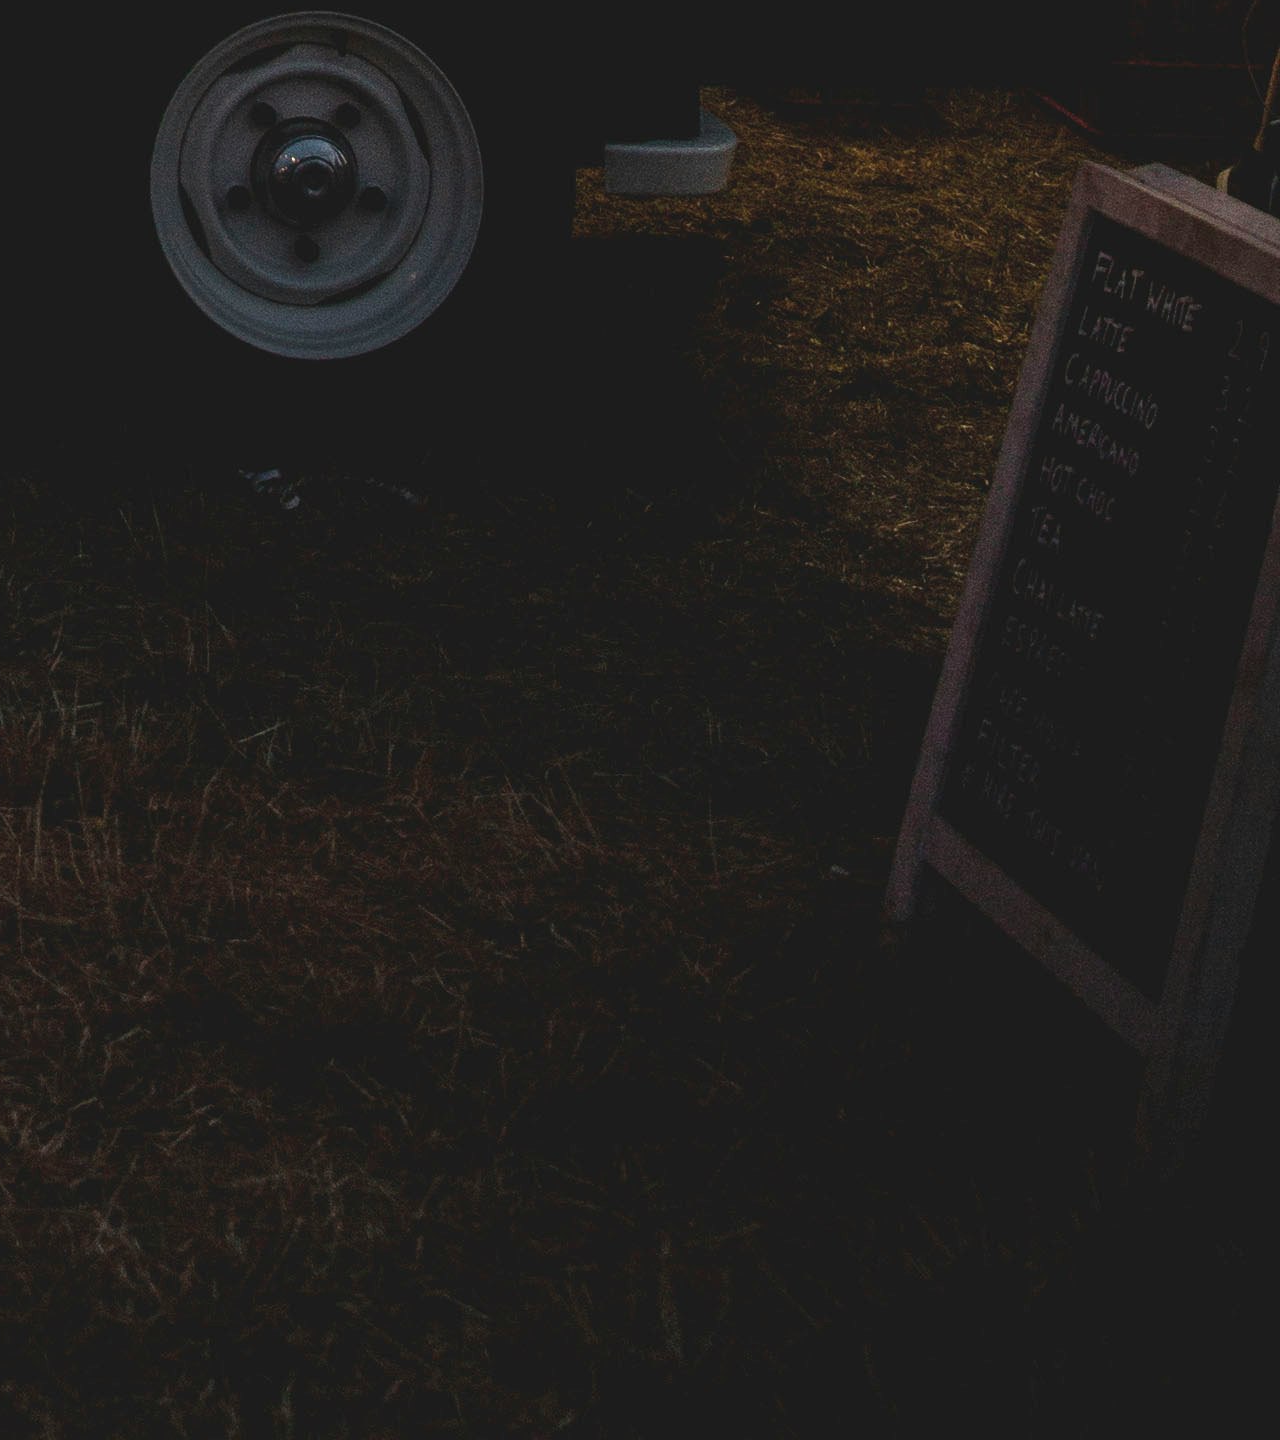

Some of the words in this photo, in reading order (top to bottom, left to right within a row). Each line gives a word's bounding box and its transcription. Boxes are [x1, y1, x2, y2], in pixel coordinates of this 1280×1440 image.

[1091, 250, 1144, 299] FLAT
[1145, 282, 1202, 331] WHITE
[1077, 305, 1134, 353] LATTE
[1064, 352, 1158, 429] CAPPUCCINO
[1038, 456, 1074, 492] HOT
[1075, 476, 1115, 522] CHOC
[1029, 505, 1061, 548] TEA
